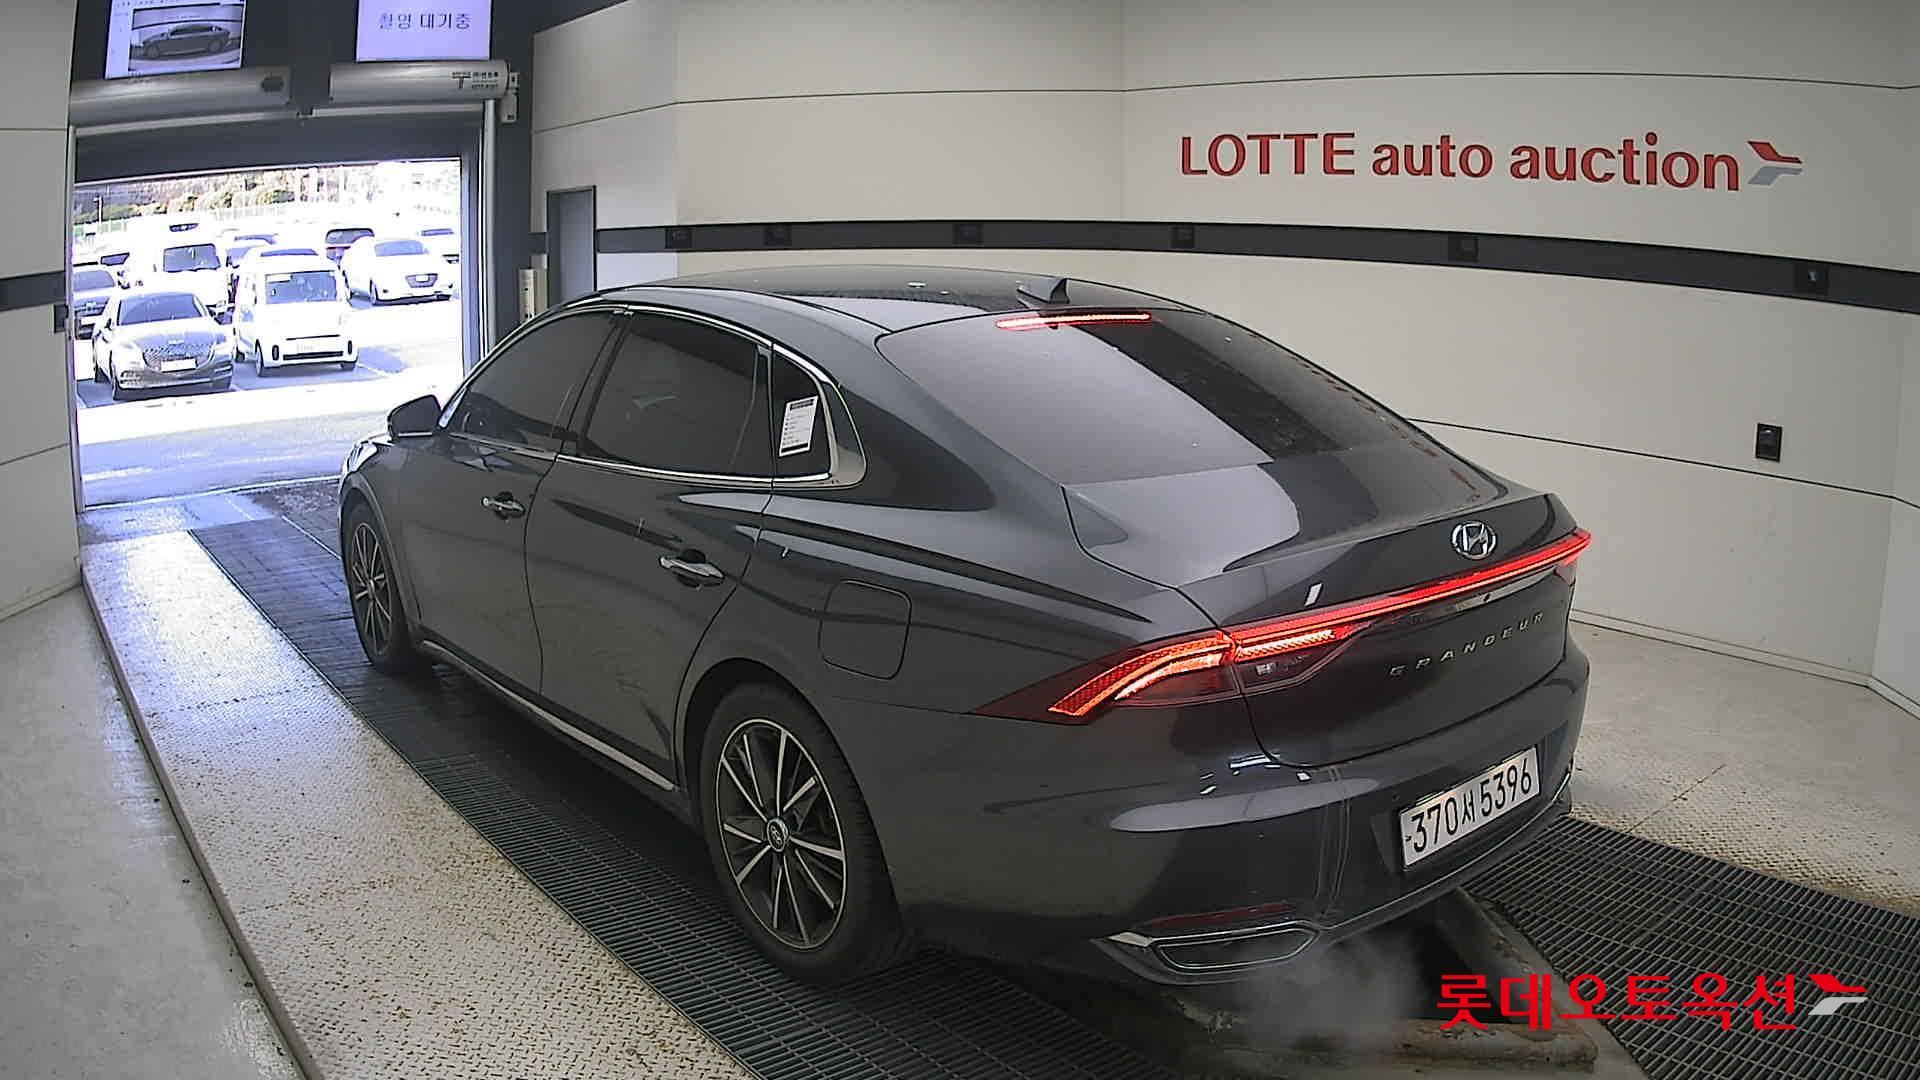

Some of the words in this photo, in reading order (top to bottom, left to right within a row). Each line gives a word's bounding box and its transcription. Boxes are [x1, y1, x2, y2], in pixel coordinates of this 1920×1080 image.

[420, 12, 473, 30] 대기중
[1181, 132, 1356, 177] LOTTE
[1371, 134, 1494, 178] auto
[1509, 131, 1740, 191] auction
[1389, 610, 1544, 677] GRANDEUR
